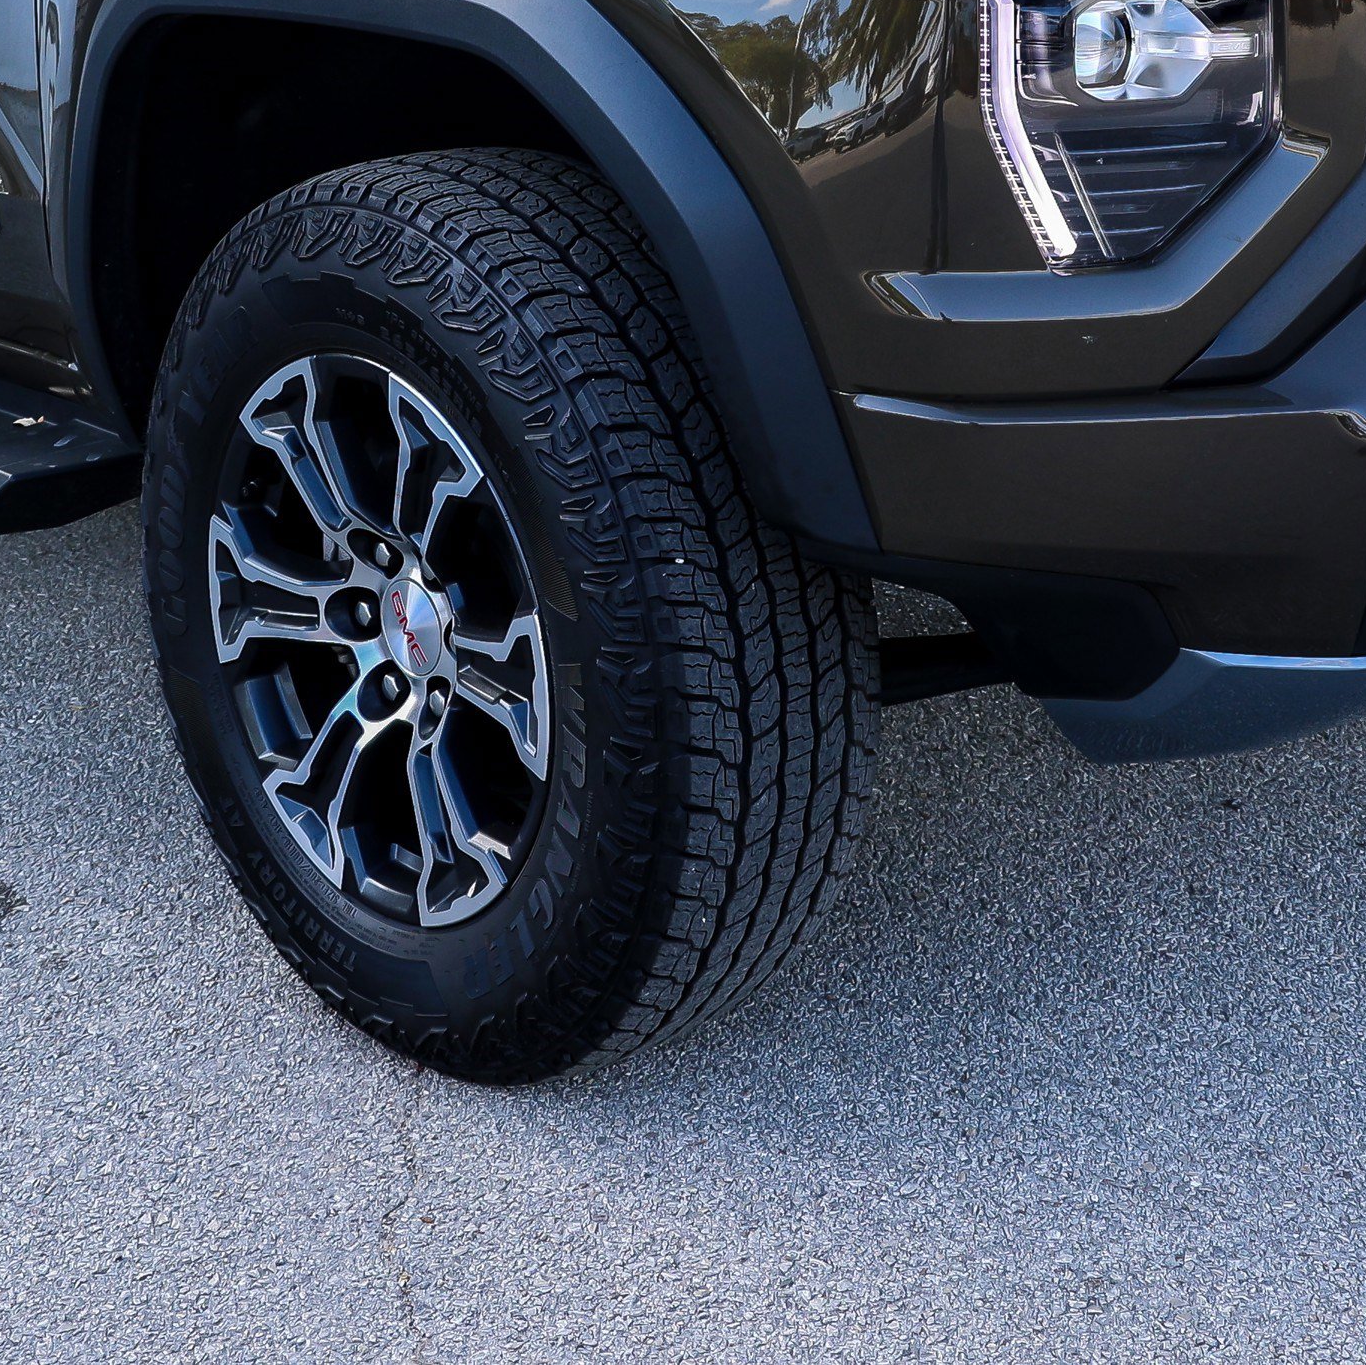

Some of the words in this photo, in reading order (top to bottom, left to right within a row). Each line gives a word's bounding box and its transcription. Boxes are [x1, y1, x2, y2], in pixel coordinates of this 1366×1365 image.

[391, 590, 428, 667] GMC
[462, 663, 586, 1000] WRANGLER
[246, 850, 357, 973] TERRITORY
